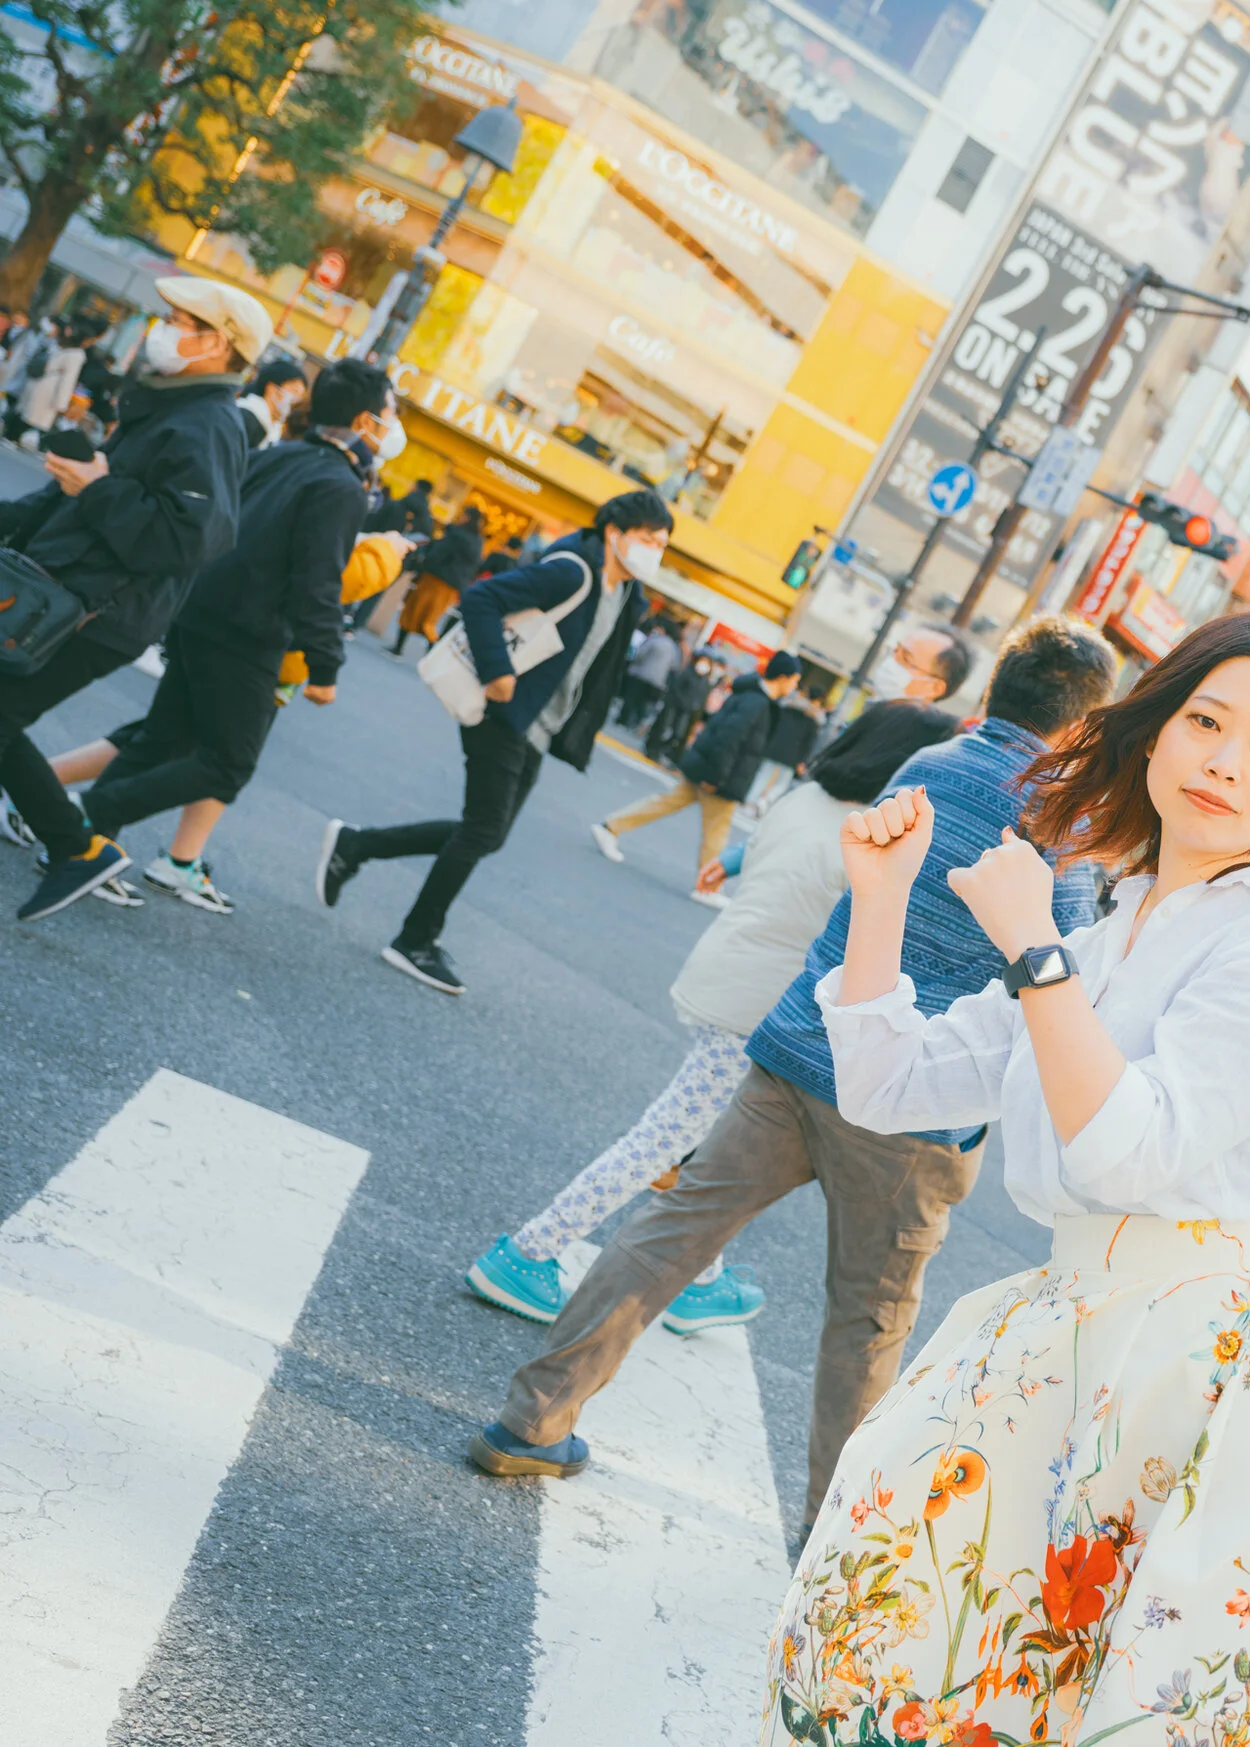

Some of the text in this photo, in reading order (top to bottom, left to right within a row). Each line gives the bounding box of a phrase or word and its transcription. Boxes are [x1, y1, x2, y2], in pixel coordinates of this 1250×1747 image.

[324, 329, 548, 467] L'CITANE
[952, 322, 1020, 390] ON
[1016, 359, 1112, 446] SAE
